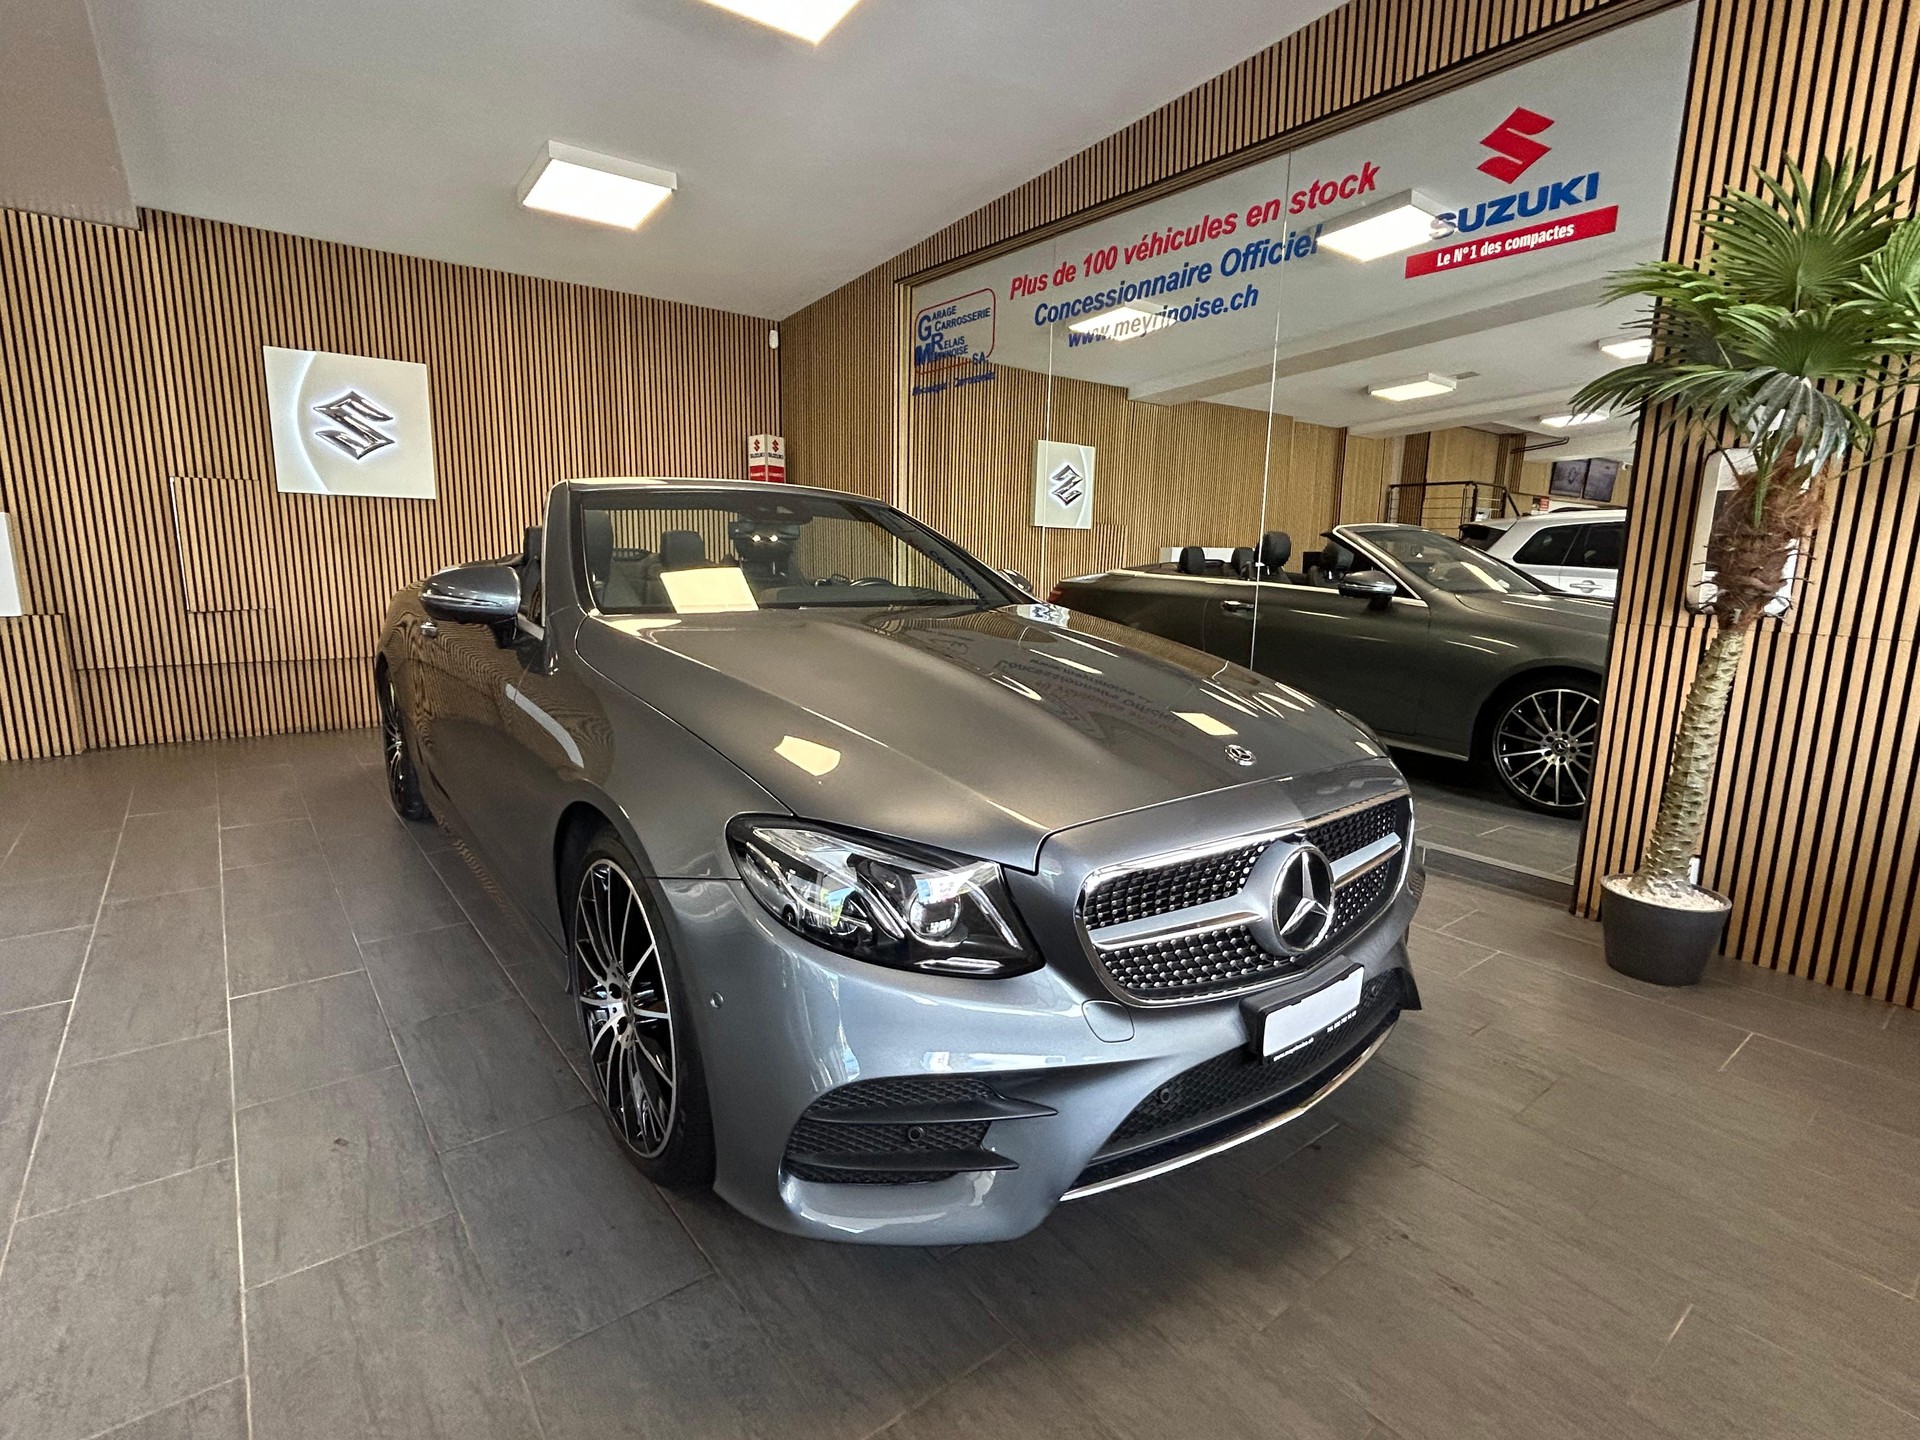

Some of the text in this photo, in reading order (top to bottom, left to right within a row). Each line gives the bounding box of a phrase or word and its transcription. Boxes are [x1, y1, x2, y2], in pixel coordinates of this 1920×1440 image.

[1010, 161, 1381, 300] Plus de 100 véhicules en stock
[1429, 171, 1600, 240] SUZUKI
[1034, 223, 1324, 327] Concessionnaire Officiel
[1437, 252, 1451, 267] Le
[1480, 240, 1502, 257] des
[1505, 223, 1575, 251] compactes
[934, 307, 991, 332] CARROSSERIE
